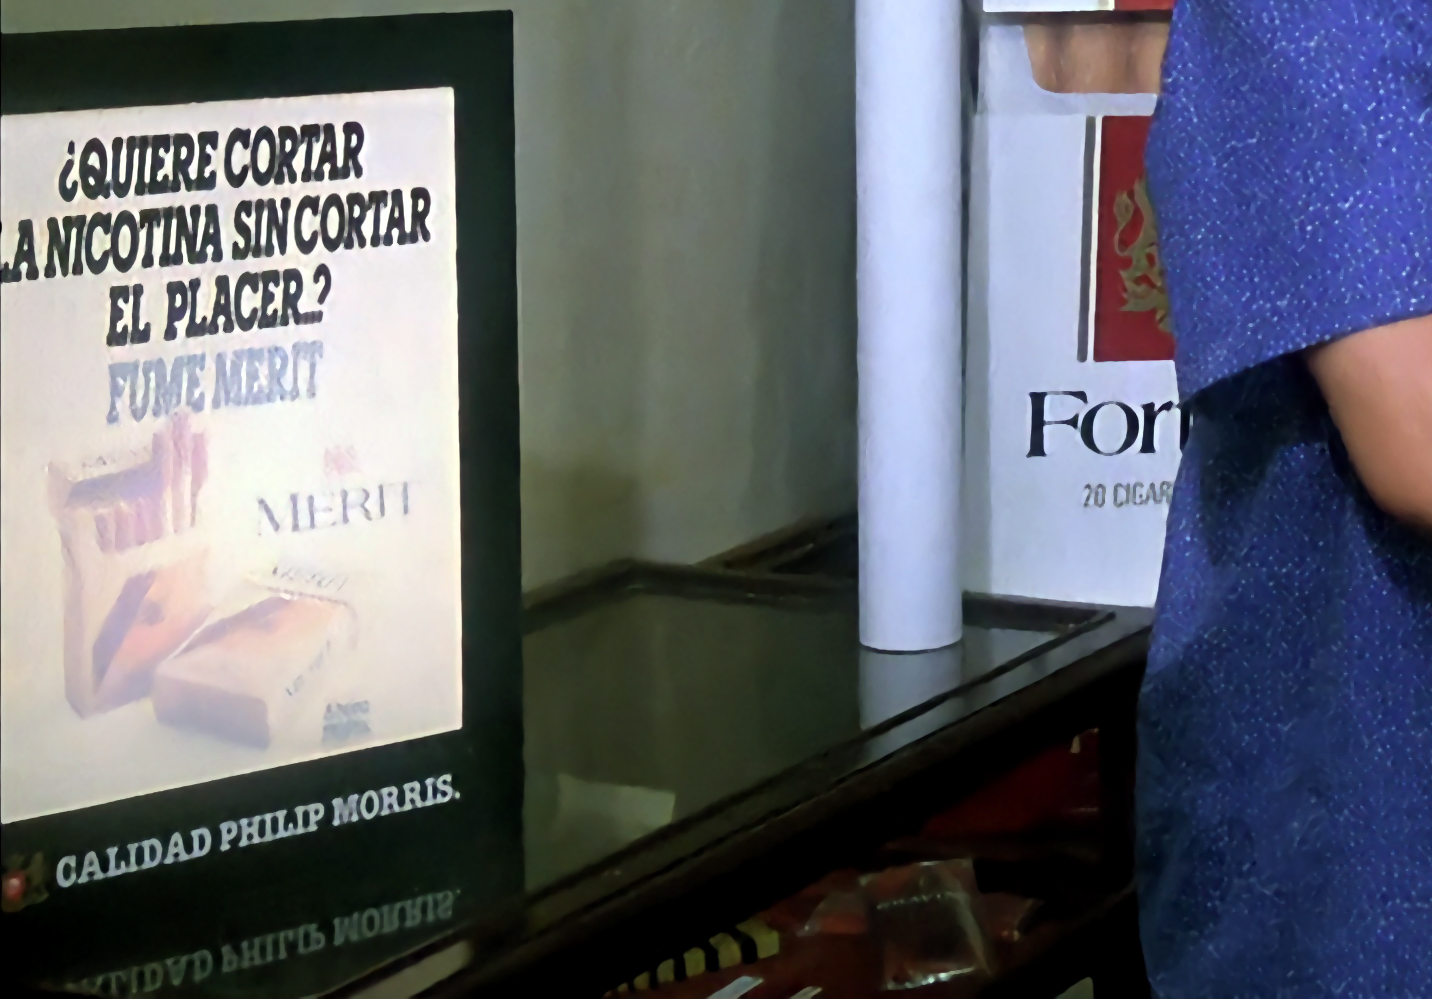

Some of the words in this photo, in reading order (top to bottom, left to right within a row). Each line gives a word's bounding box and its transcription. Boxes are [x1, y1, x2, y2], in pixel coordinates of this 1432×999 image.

[58, 130, 220, 203] ¿QUIERE
[223, 121, 365, 189] CORTAR
[44, 203, 224, 277] NICOTINA
[231, 196, 292, 261] SIN
[294, 186, 431, 255] CORTAR
[106, 283, 152, 347] EL
[106, 352, 207, 425] FUME
[211, 339, 324, 410] MERIT
[256, 480, 416, 537] MERIT
[1082, 482, 1107, 508] 20
[55, 826, 213, 889] CALIDAD
[219, 801, 325, 852] PHILIP
[331, 772, 462, 827] MORRIS.
